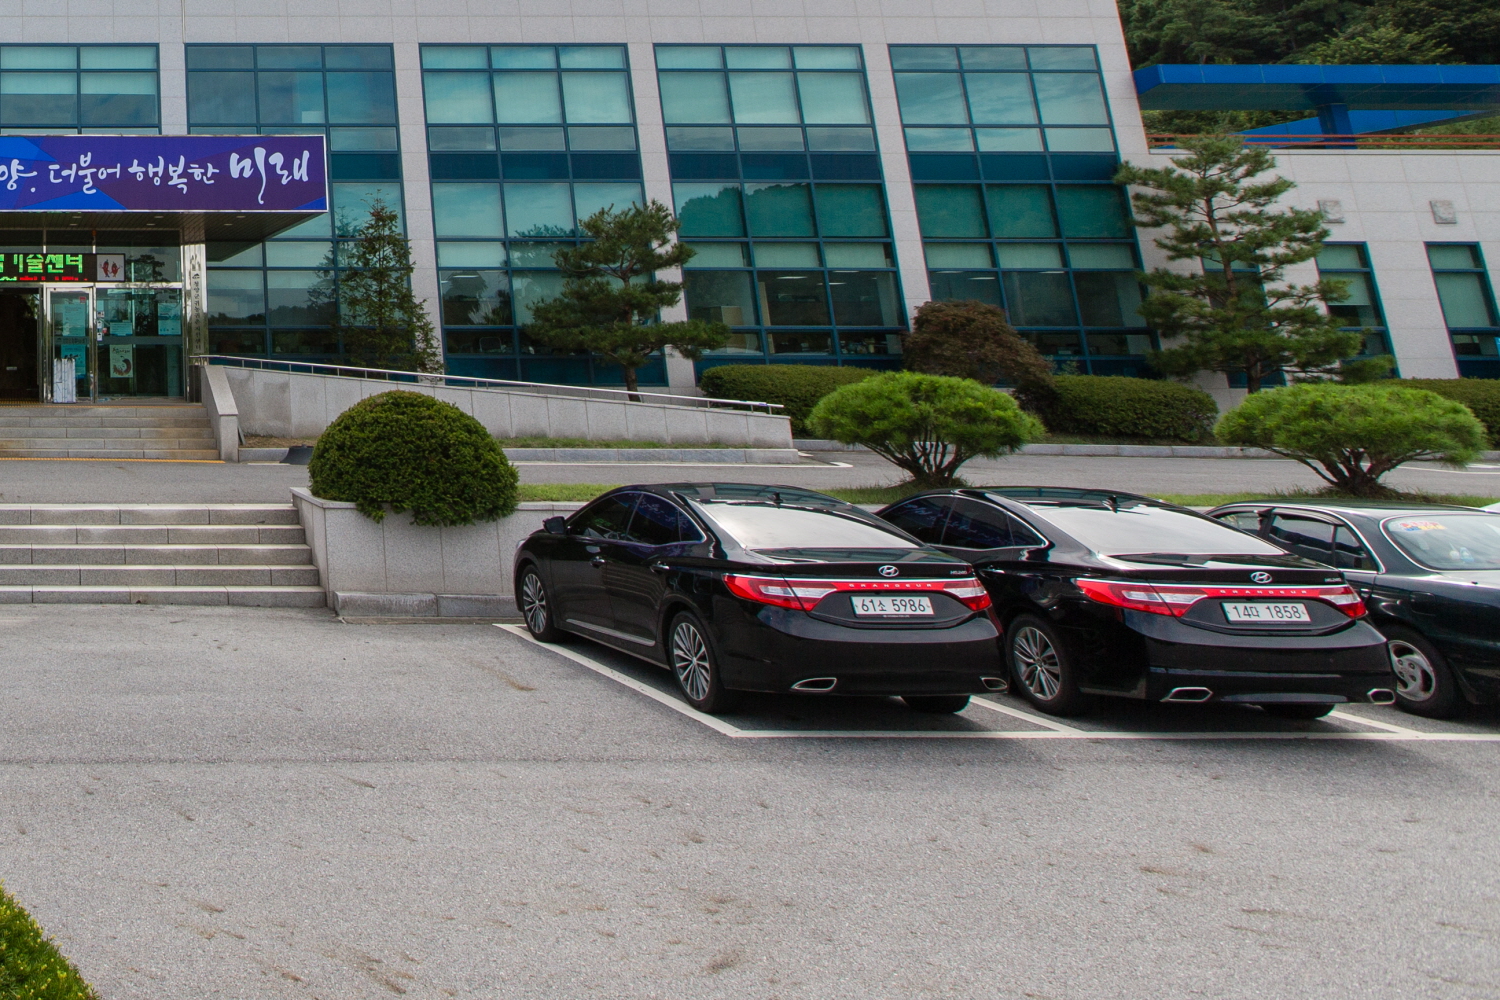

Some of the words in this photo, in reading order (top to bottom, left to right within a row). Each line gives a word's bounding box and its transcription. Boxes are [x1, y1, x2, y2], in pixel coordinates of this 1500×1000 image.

[48, 152, 120, 194] 더불어
[127, 155, 220, 194] 행복한
[229, 147, 310, 204] 미래
[861, 598, 887, 612] 61소
[891, 598, 926, 612] 5986
[1265, 605, 1302, 619] 1858
